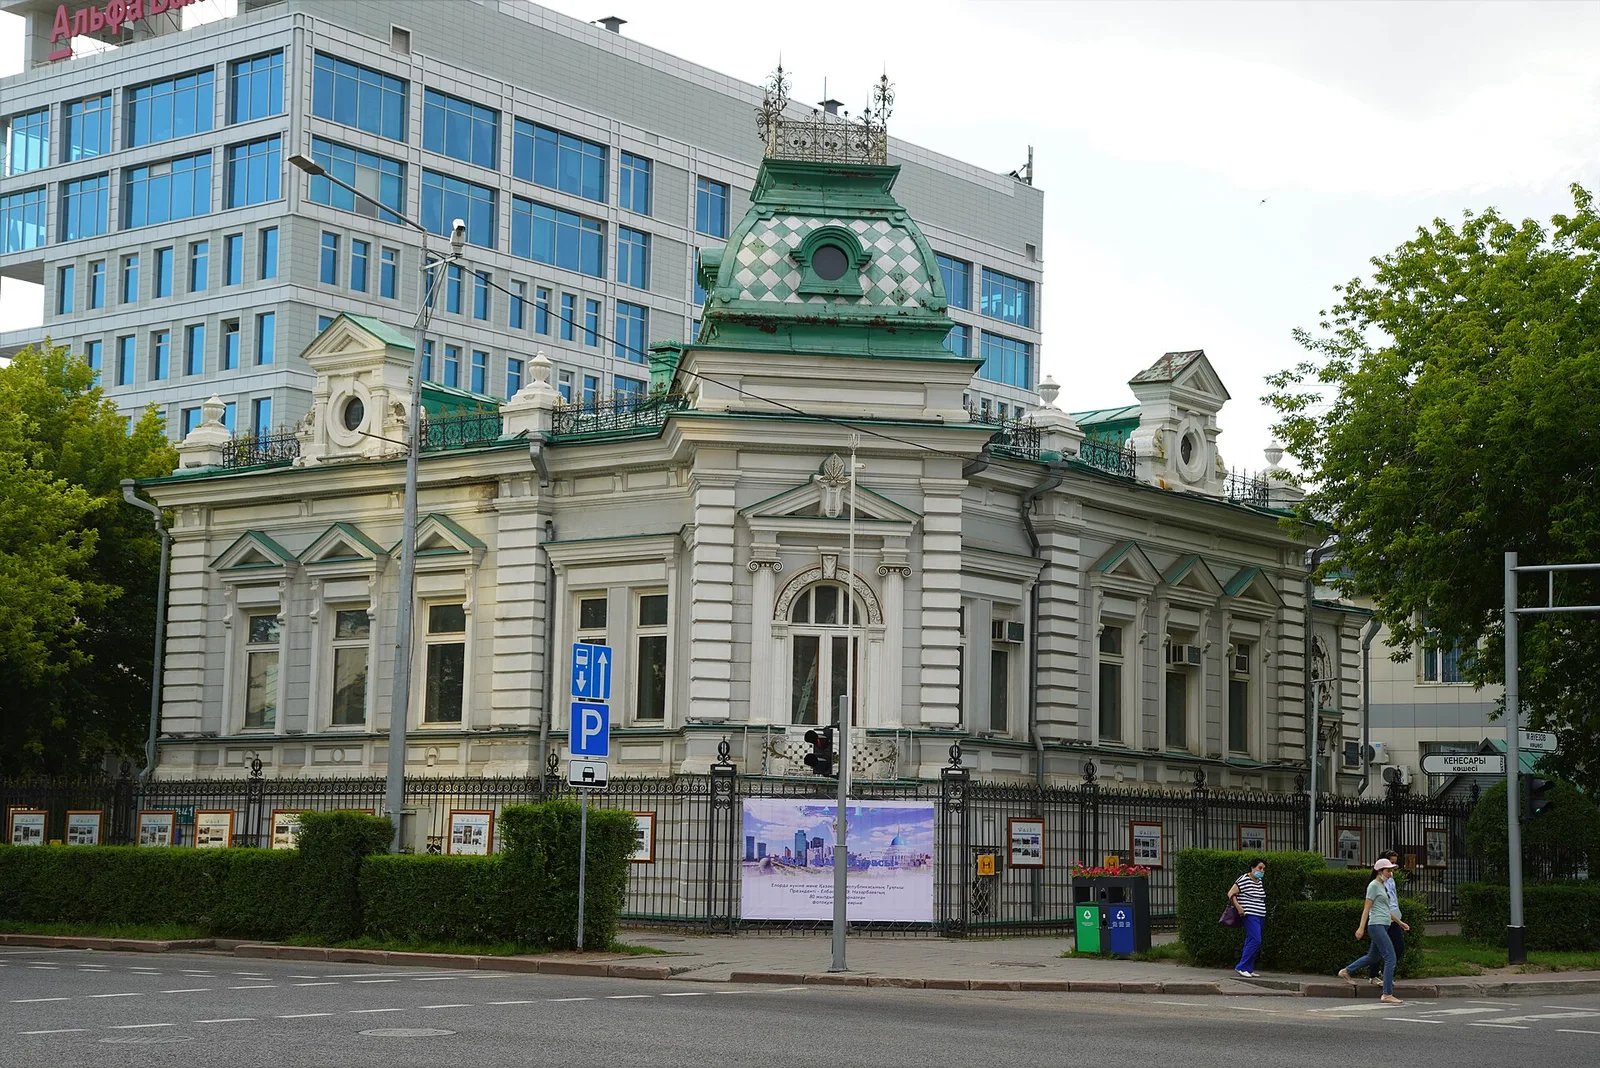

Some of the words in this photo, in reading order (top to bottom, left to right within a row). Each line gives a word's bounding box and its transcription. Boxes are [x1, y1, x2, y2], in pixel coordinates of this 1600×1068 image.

[50, 0, 144, 44] Альфа
[581, 708, 603, 750] P
[1443, 756, 1486, 765] КЕНЕСАРЫ
